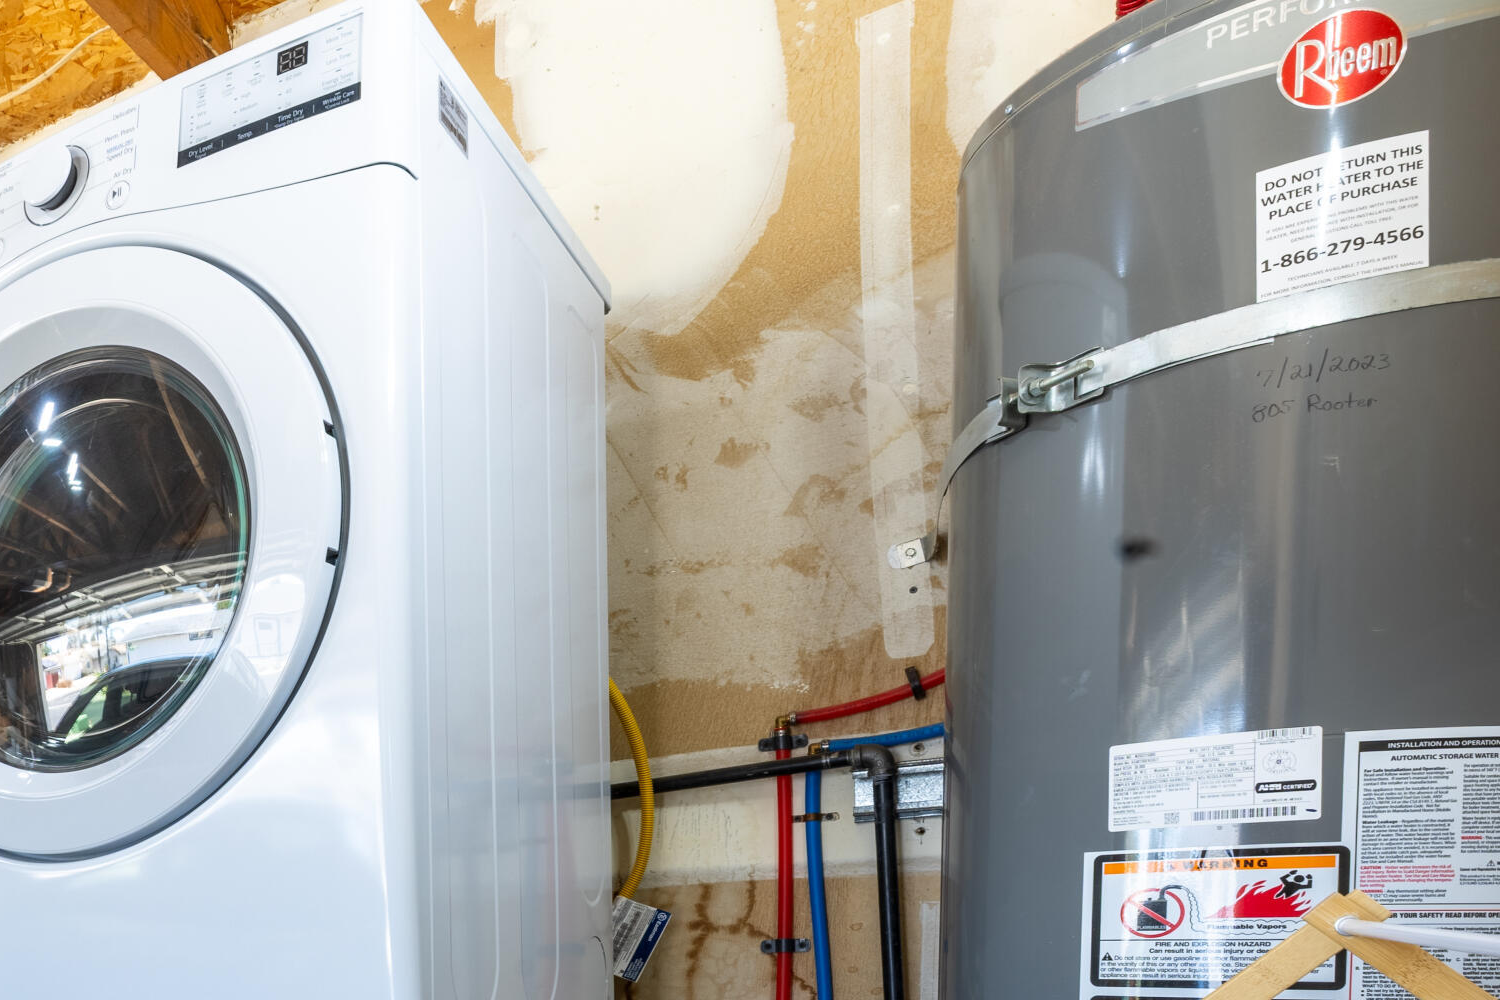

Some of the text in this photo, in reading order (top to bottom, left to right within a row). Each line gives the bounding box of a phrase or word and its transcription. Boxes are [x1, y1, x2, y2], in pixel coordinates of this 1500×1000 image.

[1206, 0, 1361, 49] PERFO
[1294, 15, 1397, 98] Rheem
[278, 112, 292, 123] Time
[293, 108, 304, 119] Dry
[342, 90, 355, 100] Care
[188, 143, 213, 158] Dry Level
[1265, 144, 1423, 192] DO NOT ETURN THIS
[1261, 160, 1424, 207] WATER HATER TO THE
[1269, 200, 1313, 221] PLACE
[1340, 176, 1418, 202] PURCHASE
[1260, 225, 1425, 274] 1-866-279-4566
[1257, 348, 1392, 389] 7/21/2023
[1307, 392, 1378, 413] Rooter
[1388, 740, 1442, 749] INSTALLATION
[1182, 858, 1269, 870] WARNING
